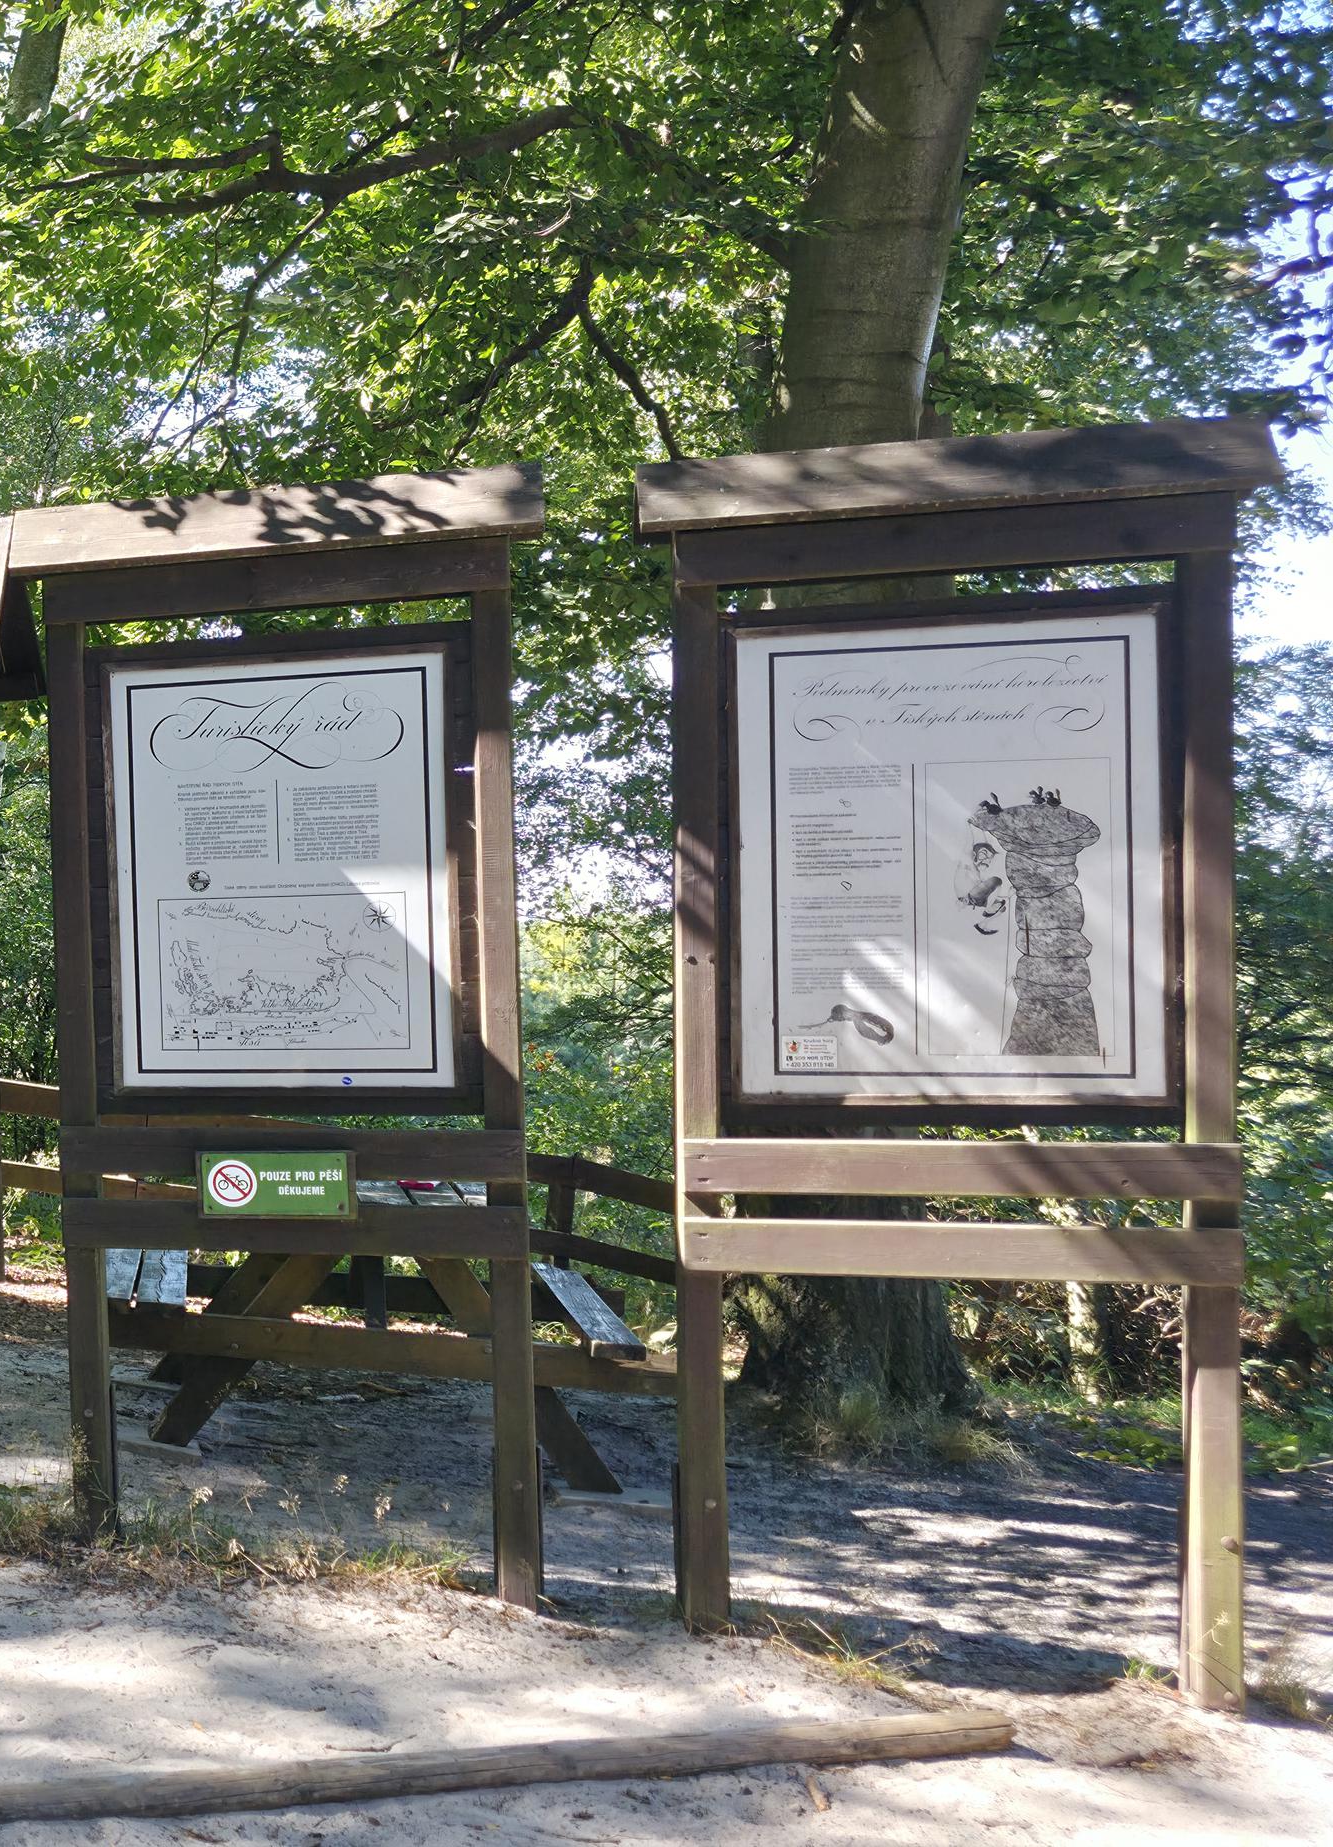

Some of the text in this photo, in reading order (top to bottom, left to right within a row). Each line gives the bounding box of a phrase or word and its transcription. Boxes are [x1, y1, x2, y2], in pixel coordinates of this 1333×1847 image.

[797, 670, 1109, 700] Podmínky provozování horolezectví
[315, 710, 363, 734] řád
[885, 704, 965, 728] Tiských
[963, 703, 1033, 722] stěnách
[259, 1169, 342, 1181] POUZE PRO PĚŠÍ
[278, 1184, 325, 1195] DĚKUJEME
